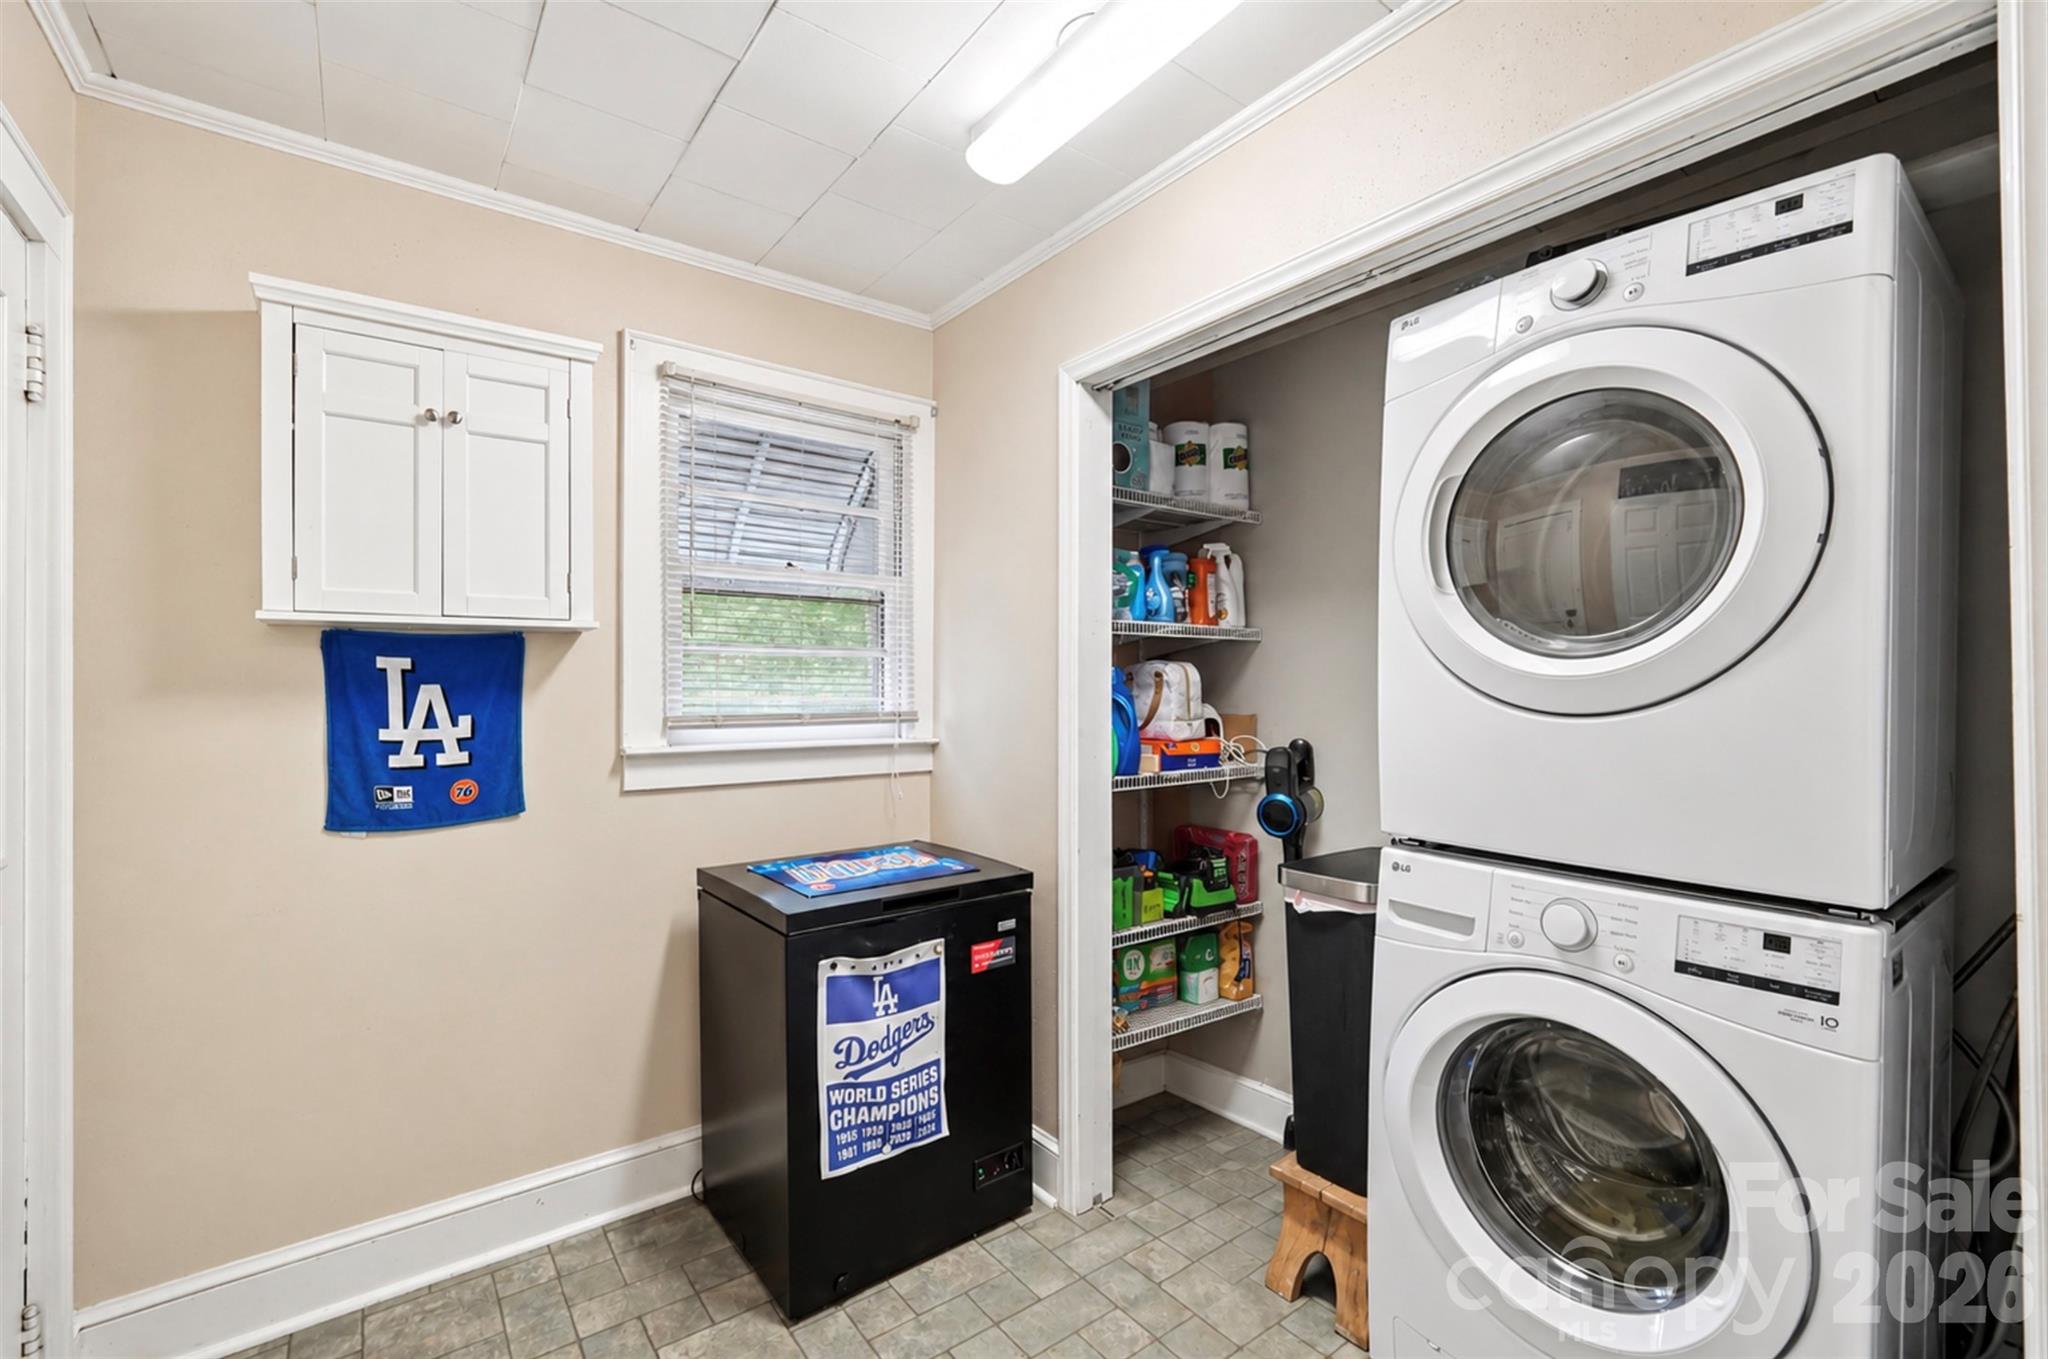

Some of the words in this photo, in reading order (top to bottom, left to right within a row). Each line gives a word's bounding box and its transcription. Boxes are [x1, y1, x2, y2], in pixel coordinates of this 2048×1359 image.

[376, 656, 472, 768] LA
[455, 785, 473, 798] 76
[872, 976, 898, 1017] LA
[833, 1012, 934, 1074] Dodgers
[829, 1085, 887, 1106] WORLD
[891, 1065, 938, 1099] SERIES
[829, 1085, 939, 1131] CHAMPIONS
